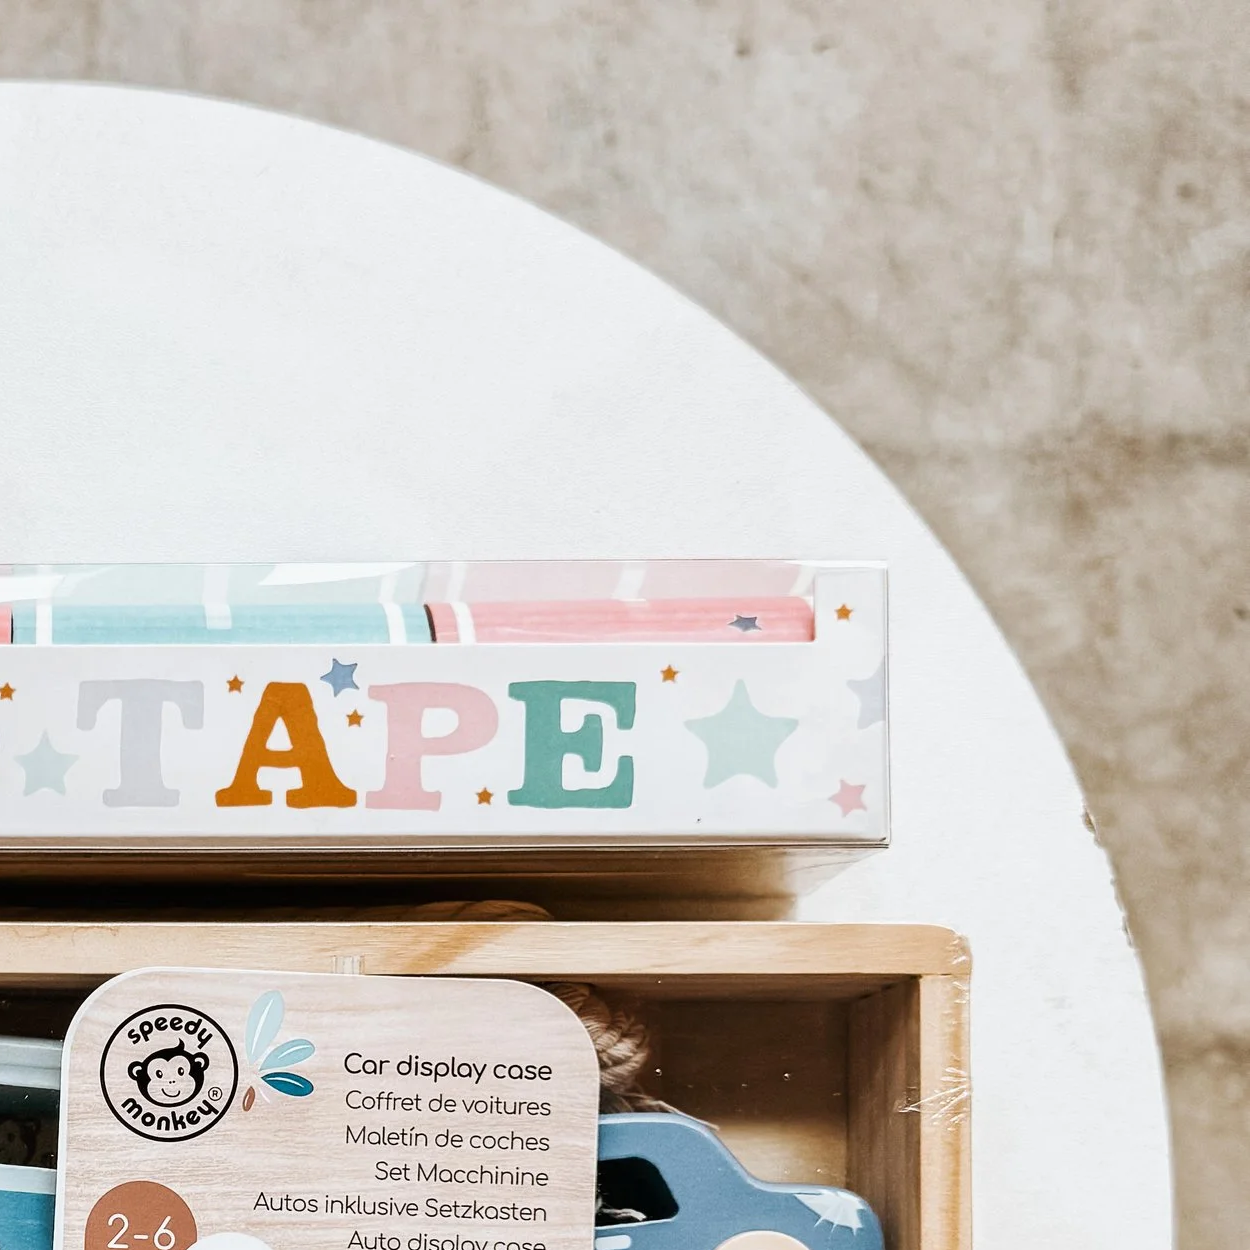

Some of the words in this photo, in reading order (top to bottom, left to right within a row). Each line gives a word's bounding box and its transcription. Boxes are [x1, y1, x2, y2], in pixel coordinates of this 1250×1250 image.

[76, 679, 637, 811] TAPE
[127, 1016, 213, 1050] speedy
[344, 1052, 391, 1075] Car
[396, 1054, 487, 1085] display
[493, 1063, 553, 1081] case
[345, 1089, 422, 1112] Coffret
[428, 1093, 457, 1113] de
[461, 1096, 551, 1117] voitures
[345, 1124, 428, 1147] Maletín
[434, 1128, 464, 1148] de
[469, 1130, 550, 1152] coches
[374, 1160, 411, 1182] Set
[417, 1162, 549, 1187] Macchinine
[253, 1191, 319, 1213] Autos
[324, 1194, 419, 1217] inklusive
[424, 1198, 547, 1222] Setzkasten
[107, 1213, 177, 1250] 2-6
[347, 1230, 401, 1250] Auto
